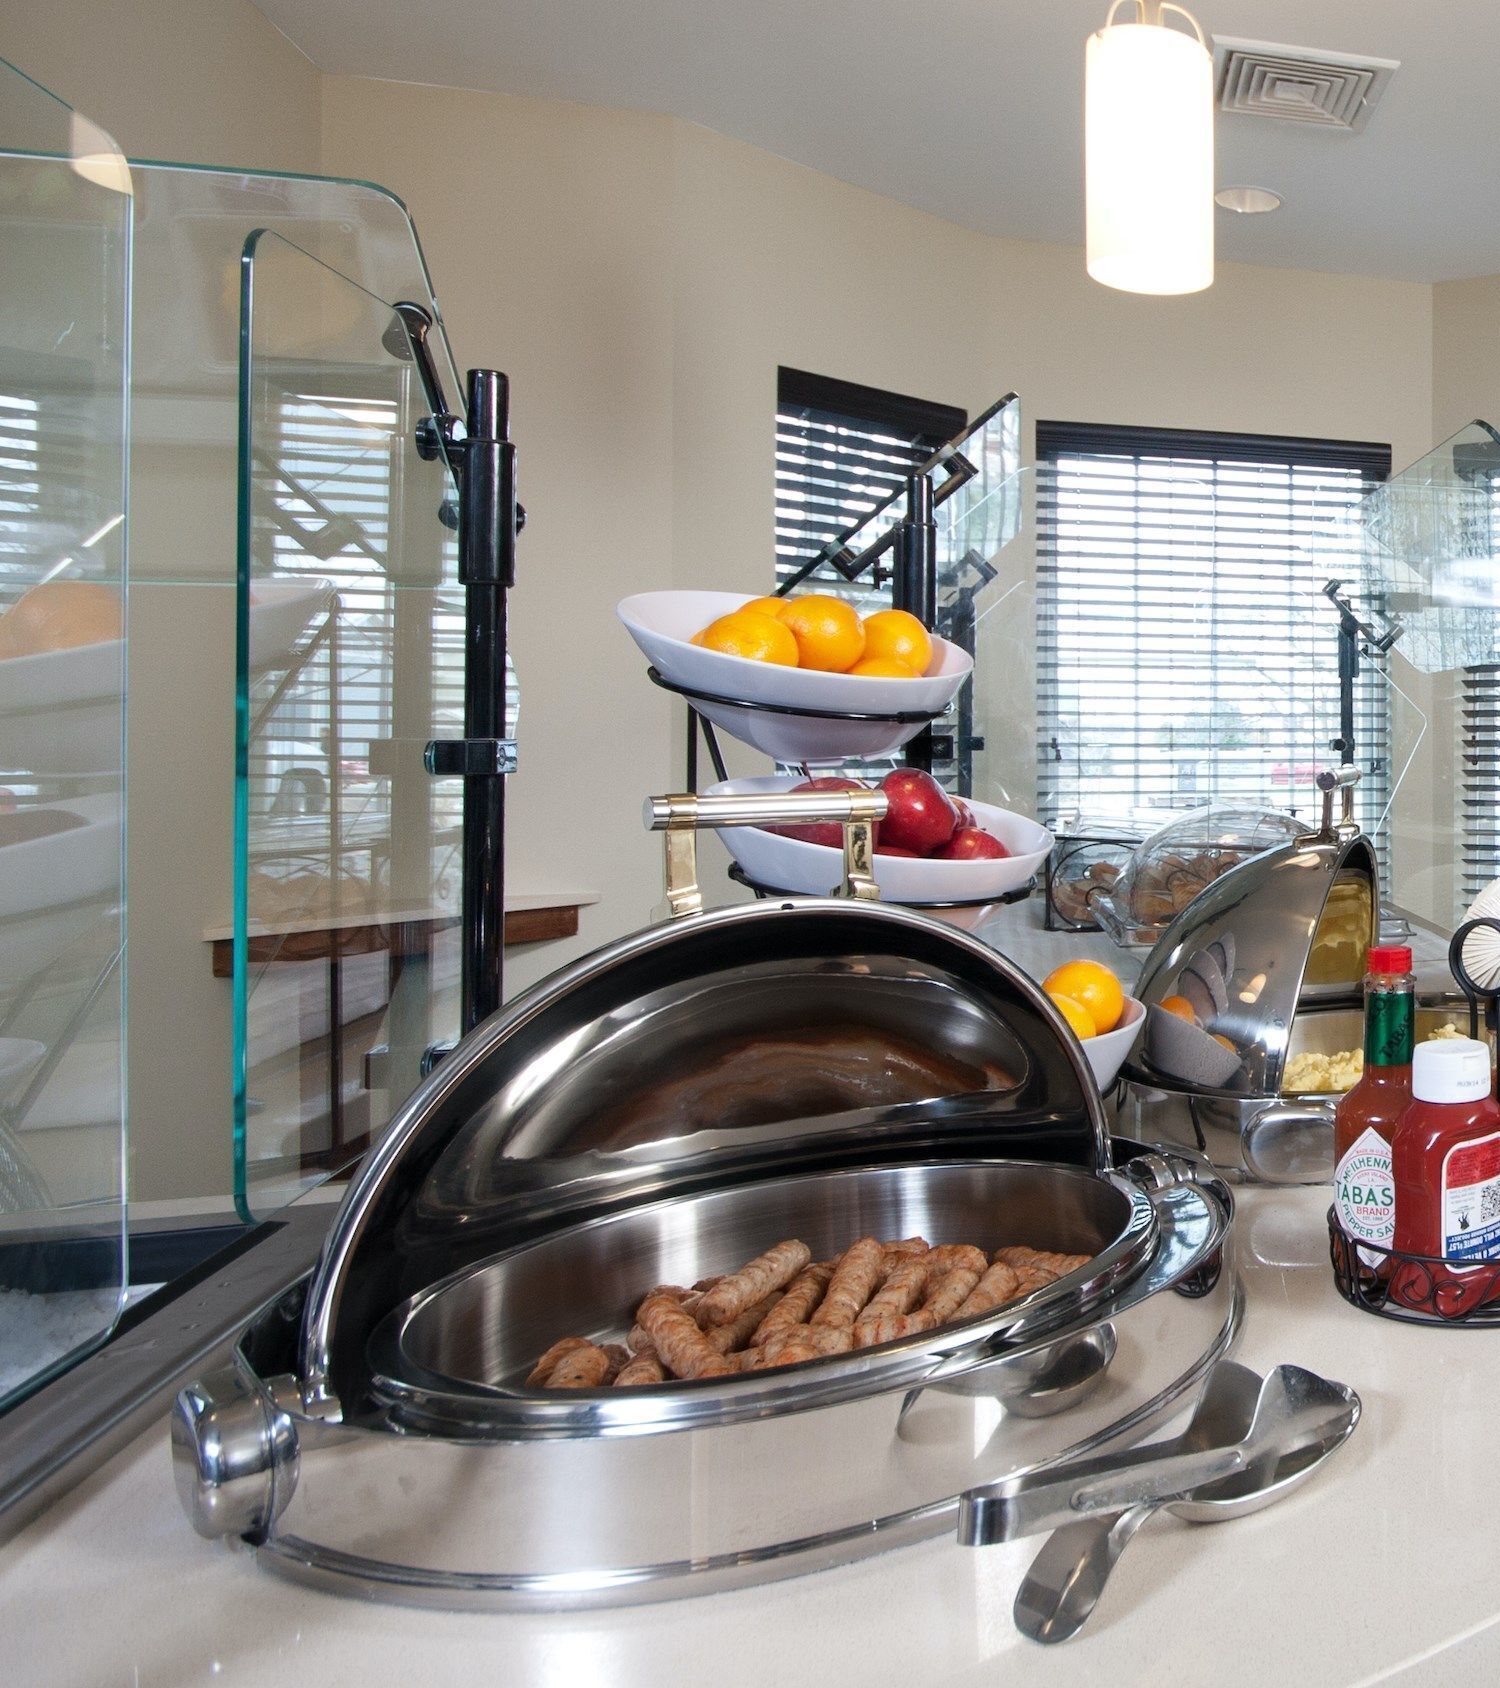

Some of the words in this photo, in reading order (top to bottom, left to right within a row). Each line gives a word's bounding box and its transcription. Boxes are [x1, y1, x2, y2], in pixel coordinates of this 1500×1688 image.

[1343, 1156, 1393, 1183] McILHENN
[1336, 1181, 1394, 1206] TABAS
[1343, 1203, 1374, 1238] PEPPER
[1356, 1206, 1390, 1216] BRAND
